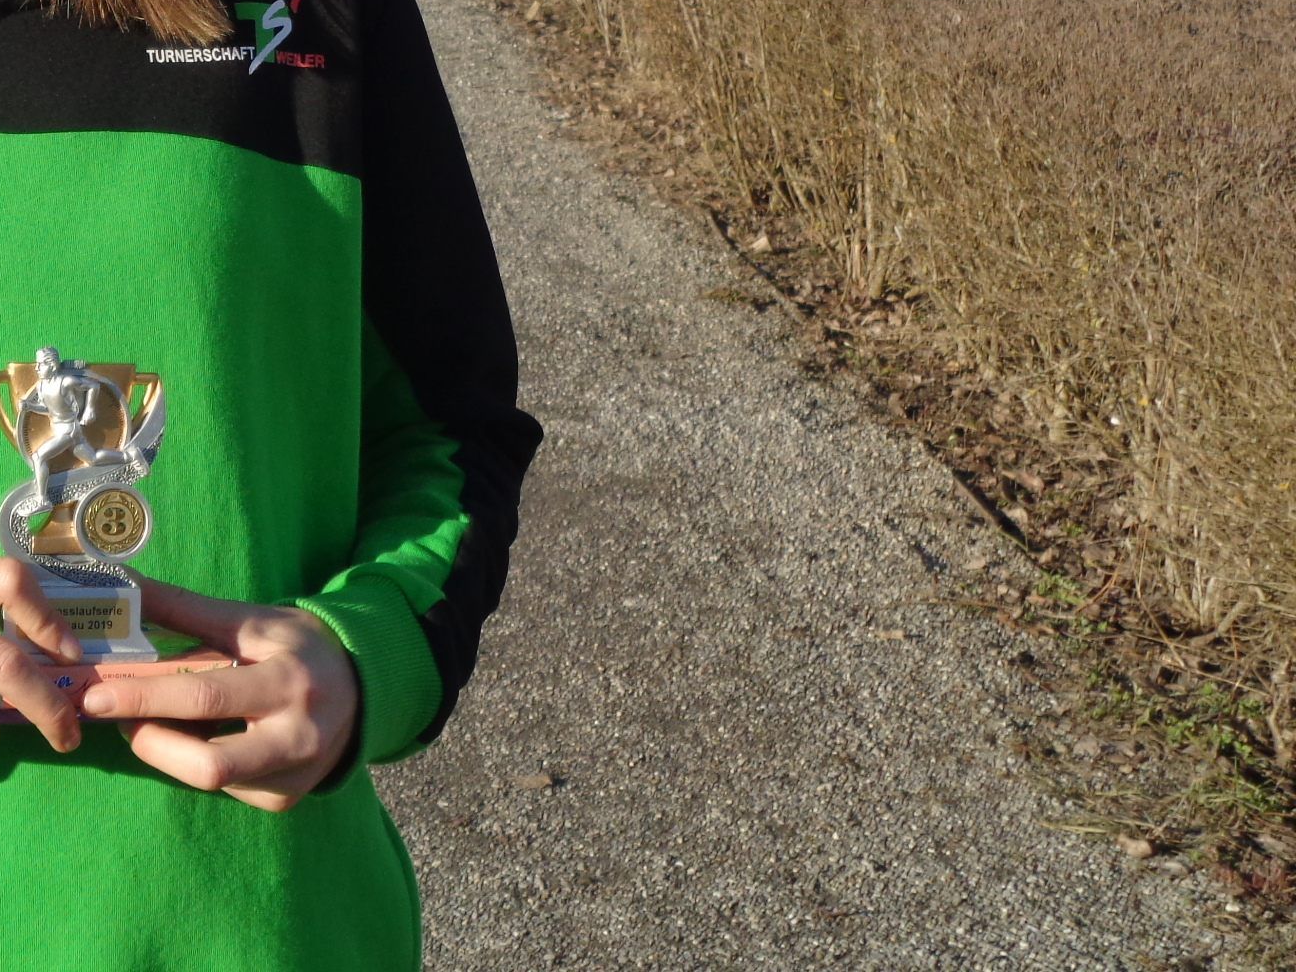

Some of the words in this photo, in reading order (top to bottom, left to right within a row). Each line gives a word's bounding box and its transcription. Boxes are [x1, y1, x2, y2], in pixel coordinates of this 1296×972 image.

[146, 46, 256, 64] TURNERSCHAFT
[276, 49, 325, 69] WEILER
[88, 620, 113, 630] 2019
